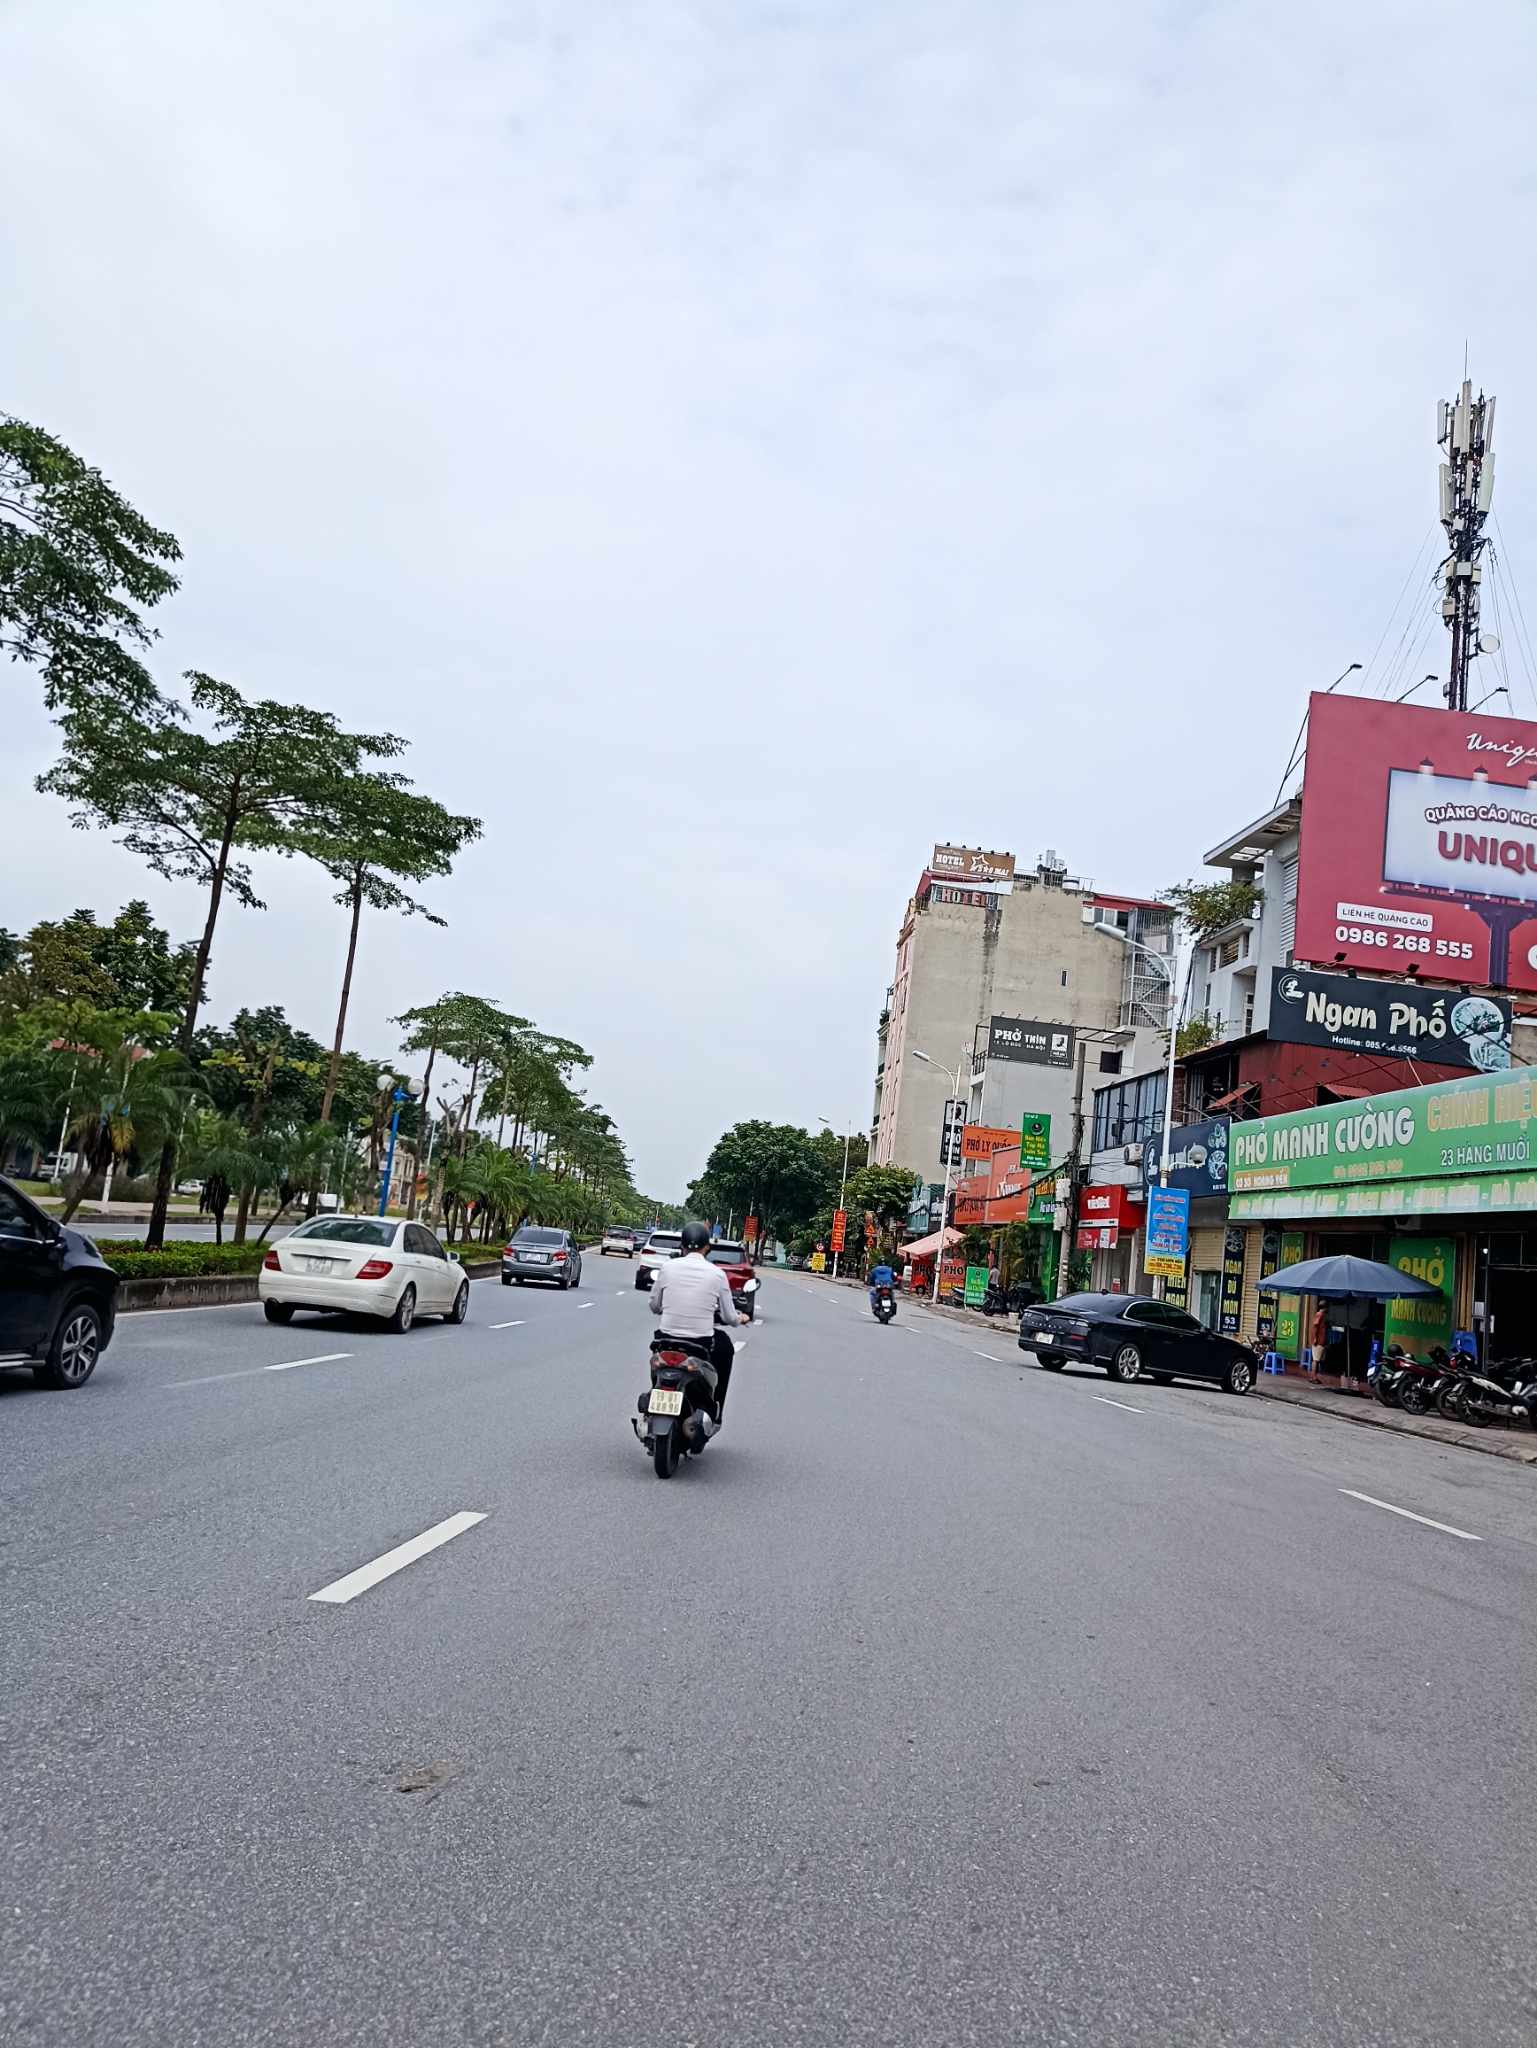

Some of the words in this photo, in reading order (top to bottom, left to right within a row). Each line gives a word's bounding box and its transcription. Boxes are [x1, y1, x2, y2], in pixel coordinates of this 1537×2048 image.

[1424, 802, 1477, 824] QUẢNG
[1478, 803, 1508, 822] CÁO
[936, 853, 964, 866] HOTEL
[1335, 926, 1389, 948] 0986
[1391, 933, 1432, 954] 268
[1435, 938, 1474, 960] 555
[1306, 991, 1377, 1032] Ngan
[1389, 999, 1447, 1039] Phố
[994, 1028, 1022, 1042] PHỞ
[1332, 1035, 1363, 1047] Hotline:
[1494, 1074, 1537, 1130] HIỆ
[1235, 1120, 1268, 1166] PHỞ
[1335, 1101, 1415, 1153] CƯỜNG
[1441, 1149, 1454, 1166] 23
[1224, 1316, 1236, 1325] 53
[1281, 1320, 1295, 1337] 23
